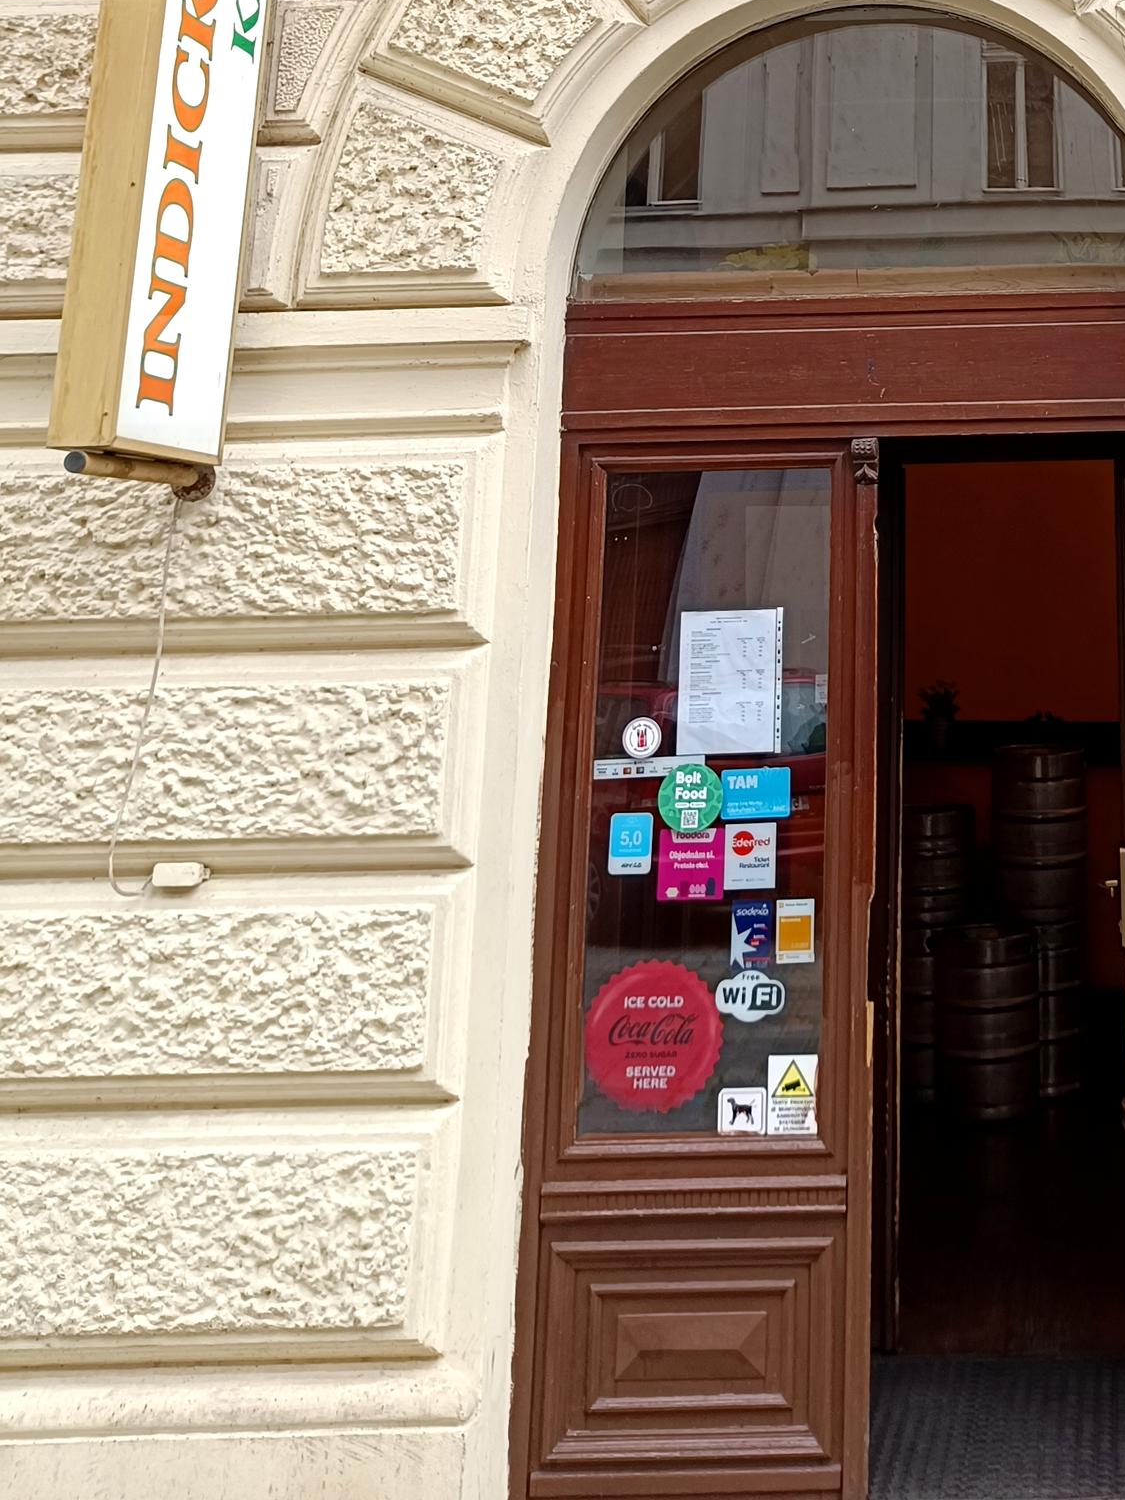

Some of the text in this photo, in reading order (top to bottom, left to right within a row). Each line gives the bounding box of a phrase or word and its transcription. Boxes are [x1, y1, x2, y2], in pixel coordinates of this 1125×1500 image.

[675, 771, 702, 787] Bolt
[727, 775, 758, 790] TAM
[675, 787, 708, 800] Food
[620, 831, 642, 848] 5,0
[732, 837, 771, 848] Edenred
[736, 906, 769, 917] sodexo
[624, 995, 684, 1009] ICE COLD
[625, 1065, 677, 1077] SERVED
[633, 1077, 668, 1090] HERE
